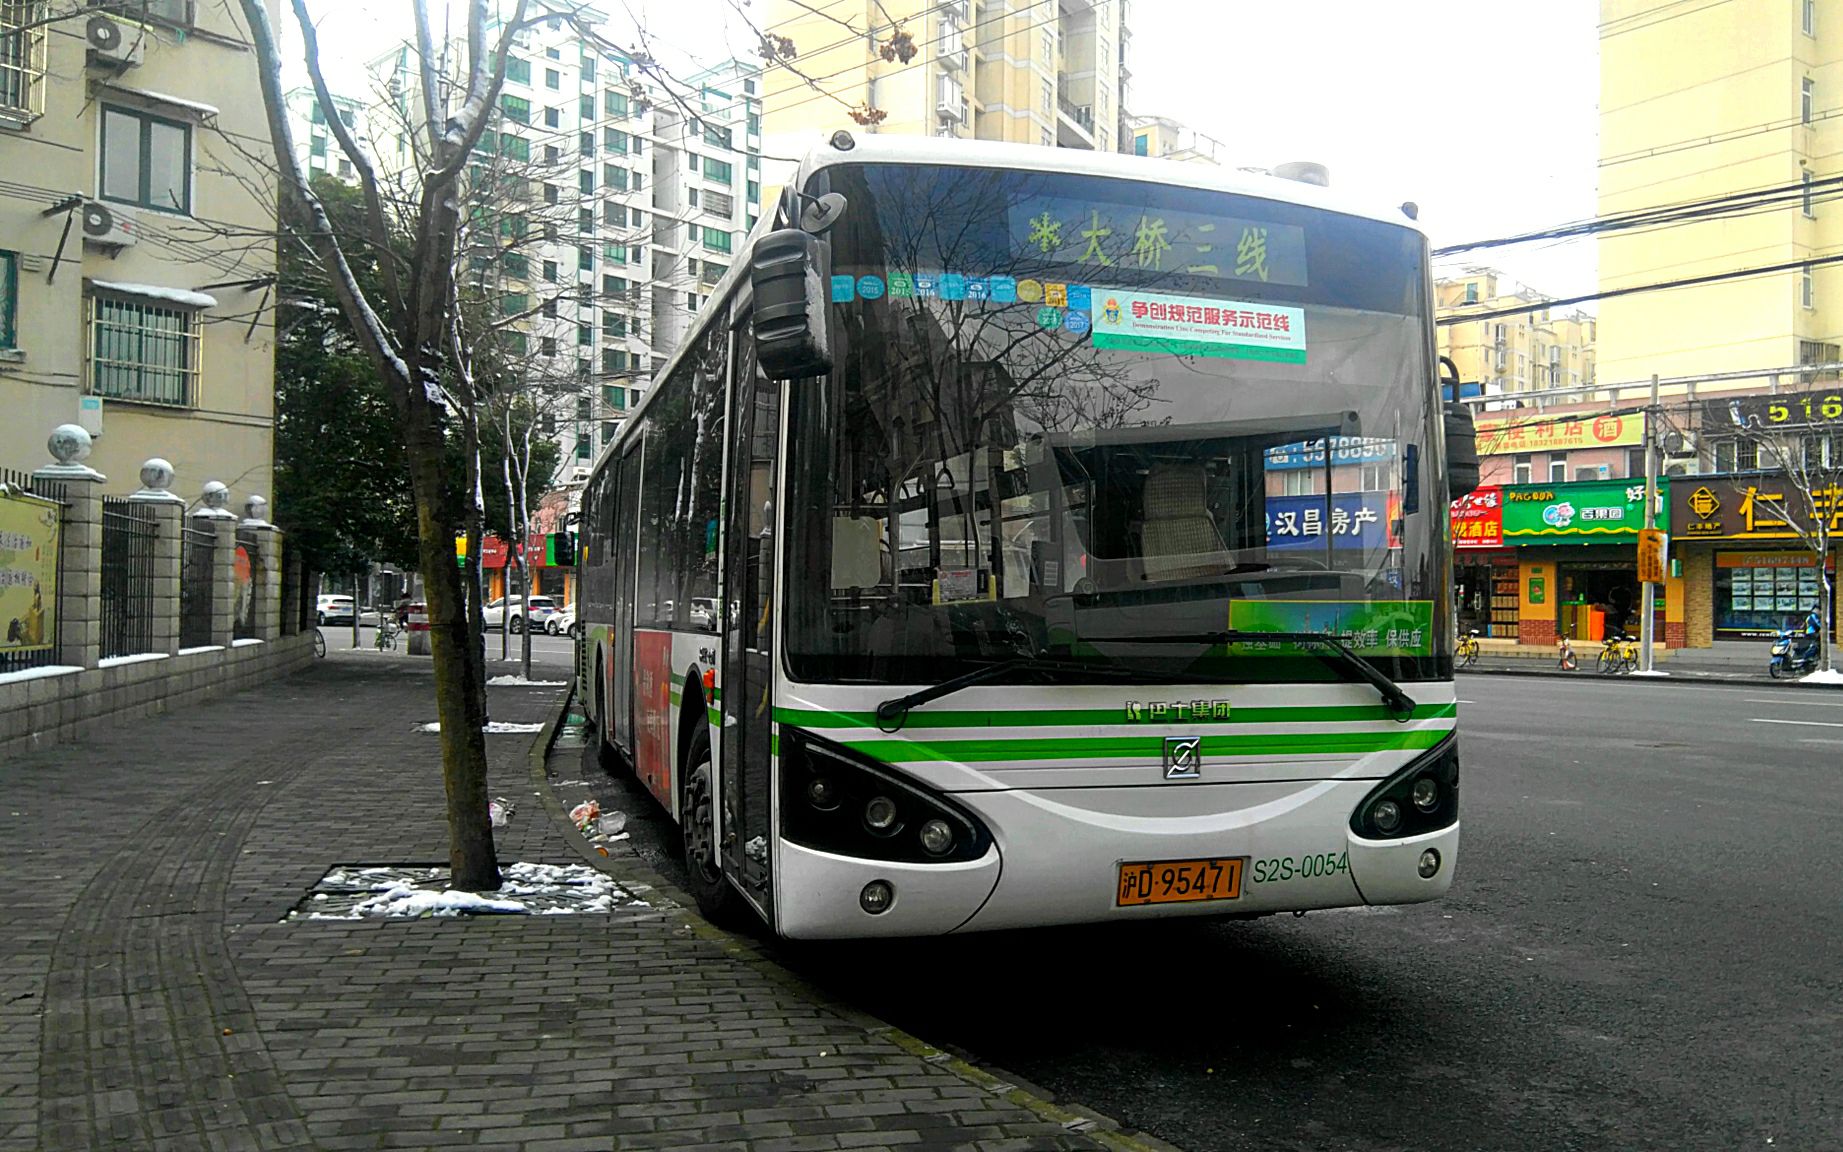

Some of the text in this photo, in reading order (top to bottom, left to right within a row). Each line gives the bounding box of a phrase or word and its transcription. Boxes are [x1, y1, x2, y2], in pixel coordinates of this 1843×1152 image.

[1078, 209, 1269, 283] 大桥三线
[1131, 300, 1290, 332] 争创规范服务示范线
[1600, 417, 1619, 437] 酒
[1274, 506, 1378, 537] 汉昌房产
[1581, 508, 1623, 520] 百果园
[1385, 628, 1422, 649] 保供应
[1148, 699, 1232, 721] 巴士集团
[1253, 851, 1348, 884] S2S-0054
